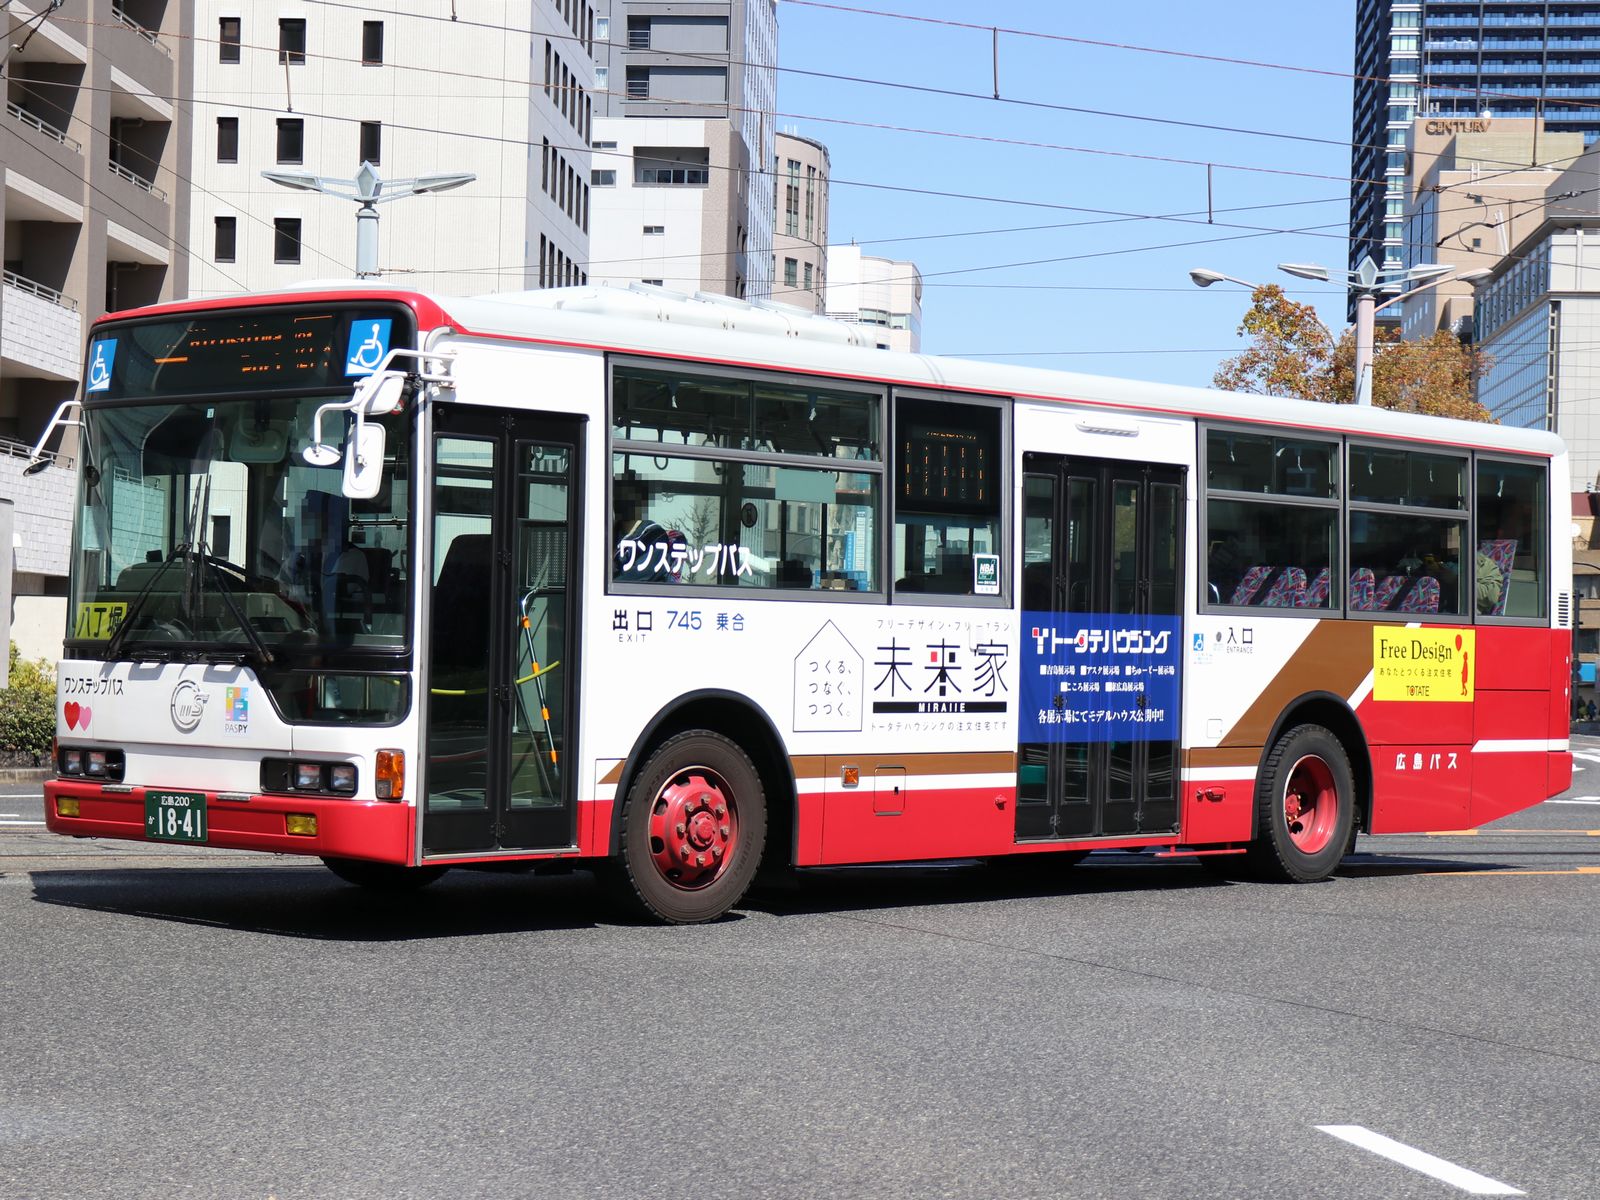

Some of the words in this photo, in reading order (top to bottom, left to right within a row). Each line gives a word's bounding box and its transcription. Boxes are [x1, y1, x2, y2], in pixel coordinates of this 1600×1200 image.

[1425, 119, 1492, 136] CENTURY
[617, 539, 753, 576] ワンステップバス
[612, 609, 653, 631] 出口
[666, 610, 703, 630] 745
[716, 612, 745, 631] 乗合
[618, 633, 647, 643] EXIT
[1051, 627, 1171, 654] トータテハウジング
[1226, 627, 1253, 644] 入口
[1226, 646, 1253, 654] ENTRANCE
[1380, 638, 1407, 659] Free
[1411, 639, 1452, 663] Design
[874, 636, 1008, 697] 未来家
[64, 677, 124, 695] ワンステップバス
[1406, 685, 1430, 697] TOTATE
[224, 723, 248, 734] PASPY
[1396, 752, 1457, 770] 広島バス
[158, 807, 202, 838] 18-41
